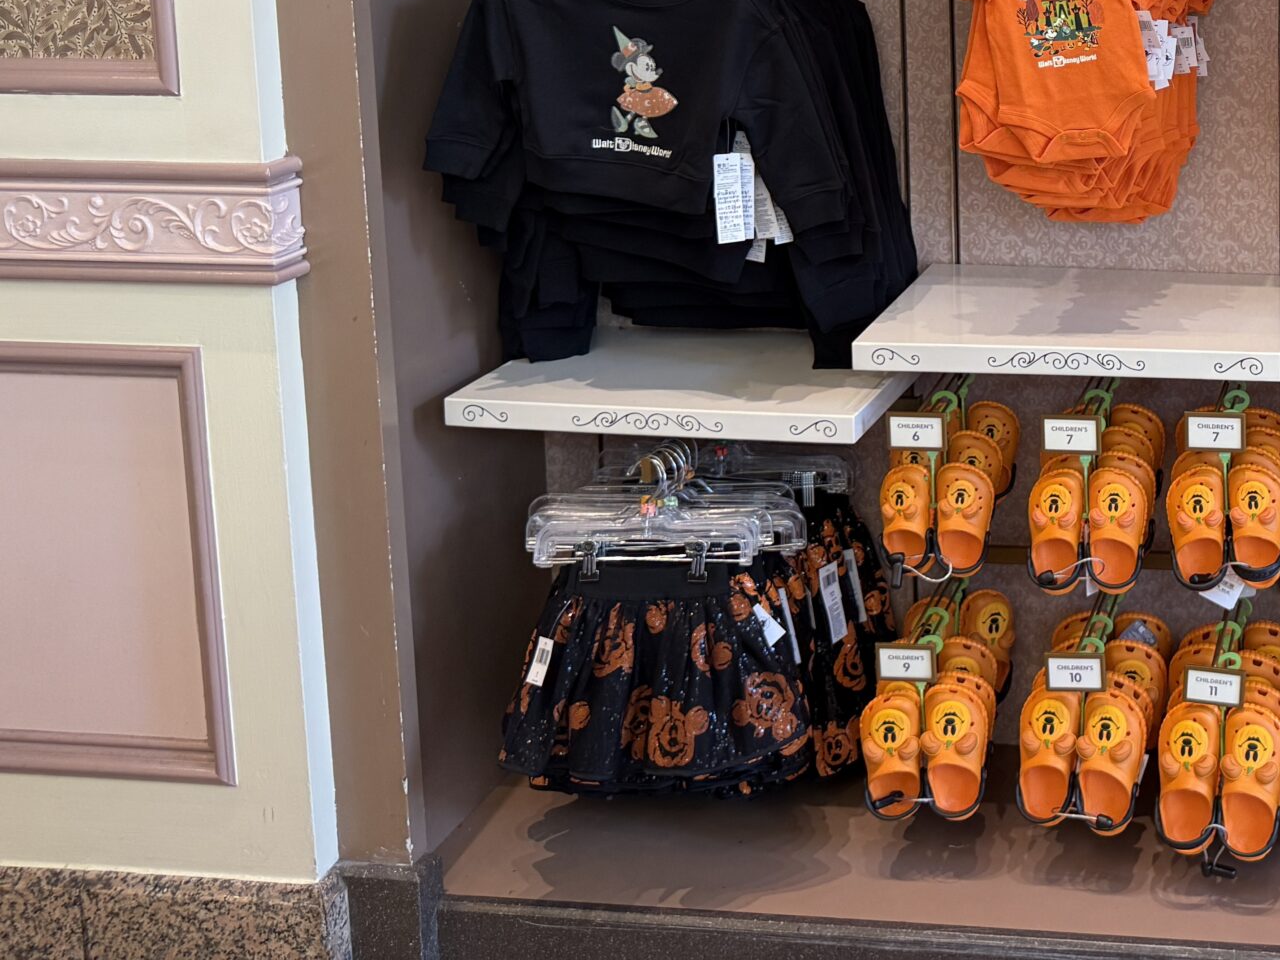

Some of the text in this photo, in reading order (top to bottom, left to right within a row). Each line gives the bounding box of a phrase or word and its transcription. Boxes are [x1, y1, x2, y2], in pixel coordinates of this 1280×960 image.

[592, 138, 614, 149] Walt
[912, 431, 920, 441] 6
[1066, 434, 1073, 445] 7
[1212, 432, 1220, 442] 7
[903, 662, 911, 672] 9
[1069, 672, 1082, 683] 10
[1195, 676, 1233, 686] CHILDREN'S
[1209, 685, 1218, 696] 11
